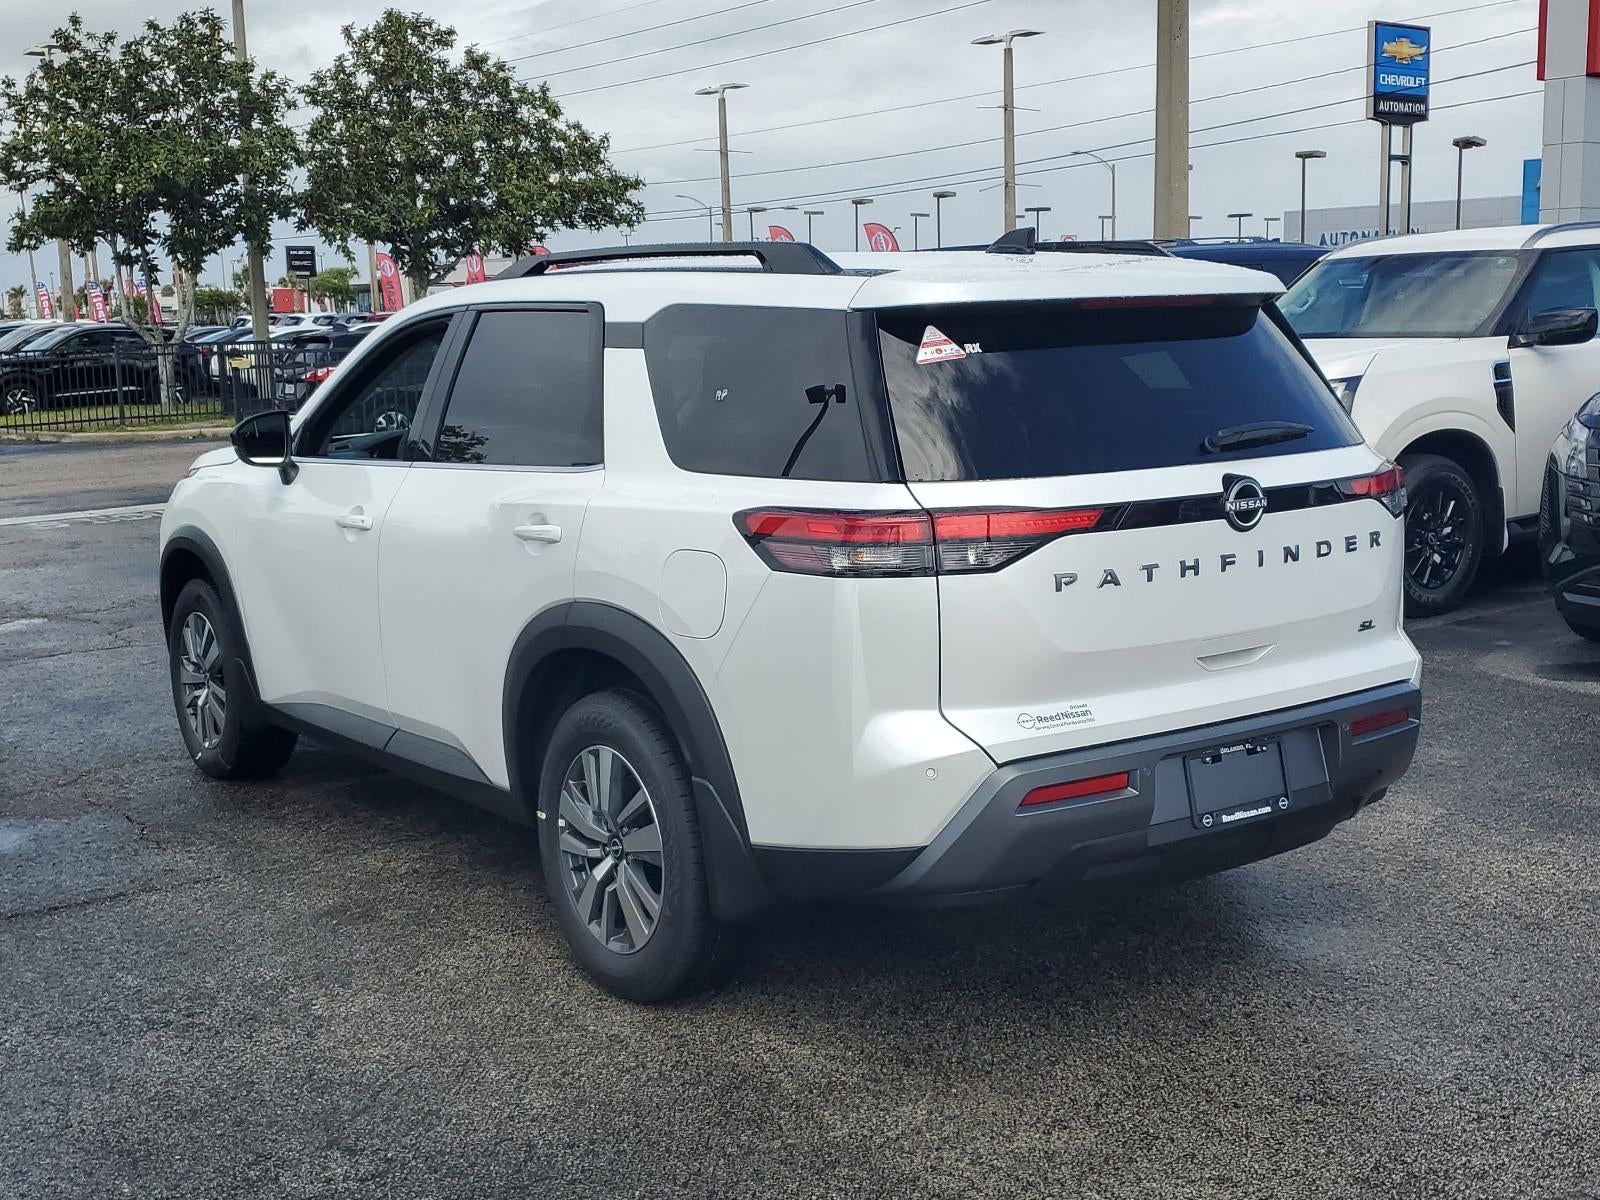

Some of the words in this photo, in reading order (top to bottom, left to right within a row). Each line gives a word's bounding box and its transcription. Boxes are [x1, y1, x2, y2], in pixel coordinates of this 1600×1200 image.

[1380, 74, 1426, 87] CHEVROLET
[1379, 101, 1426, 114] AUTONATION
[1225, 497, 1267, 513] NISSAN
[1054, 530, 1382, 593] PATHFINDER
[1357, 619, 1377, 632] SL
[1222, 806, 1272, 823] ReedNissan.com
